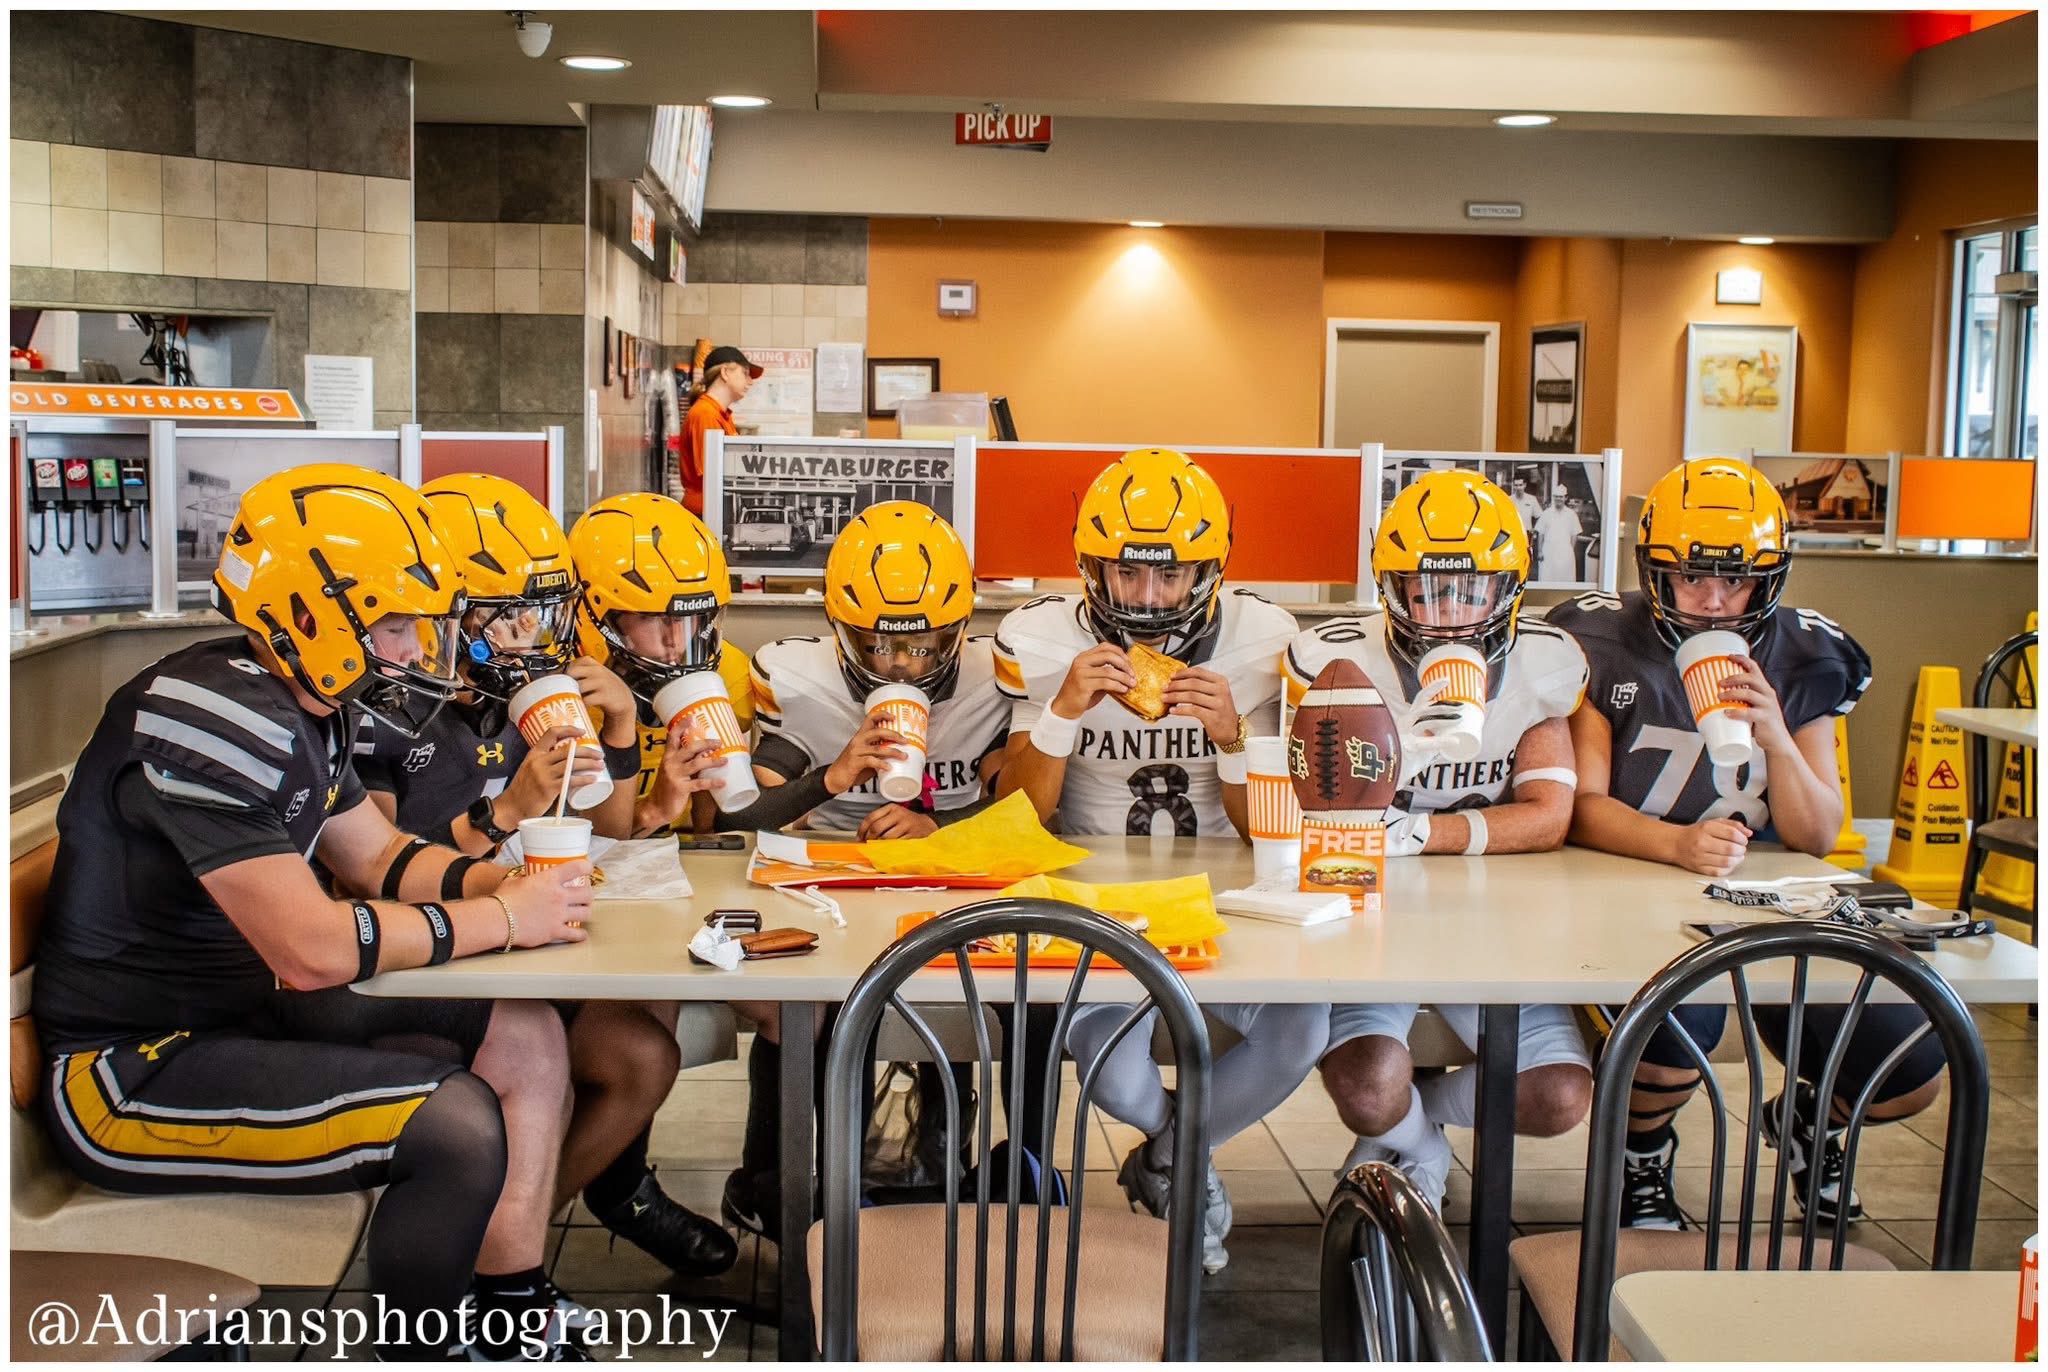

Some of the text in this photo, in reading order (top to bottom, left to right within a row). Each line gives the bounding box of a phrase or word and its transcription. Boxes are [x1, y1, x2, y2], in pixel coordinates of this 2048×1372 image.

[964, 113, 1041, 140] PICK UP
[744, 351, 784, 362] OKING
[11, 391, 68, 406] OLD
[87, 393, 244, 411] BEVERAGES
[741, 455, 950, 479] WHATABURGER
[1124, 547, 1172, 560] Riddell
[1703, 548, 1728, 556] LIBERTY
[1423, 558, 1472, 569] Riddell
[536, 572, 568, 588] LIBERTY
[674, 596, 715, 611] Riddell
[879, 619, 926, 631] Riddell
[1931, 724, 1960, 733] CAUTION
[1078, 727, 1217, 760] PANTHER
[1409, 750, 1514, 790] NTHERS
[1628, 724, 1770, 832] 78
[1126, 763, 1198, 836] 8
[1303, 828, 1383, 856] FREE
